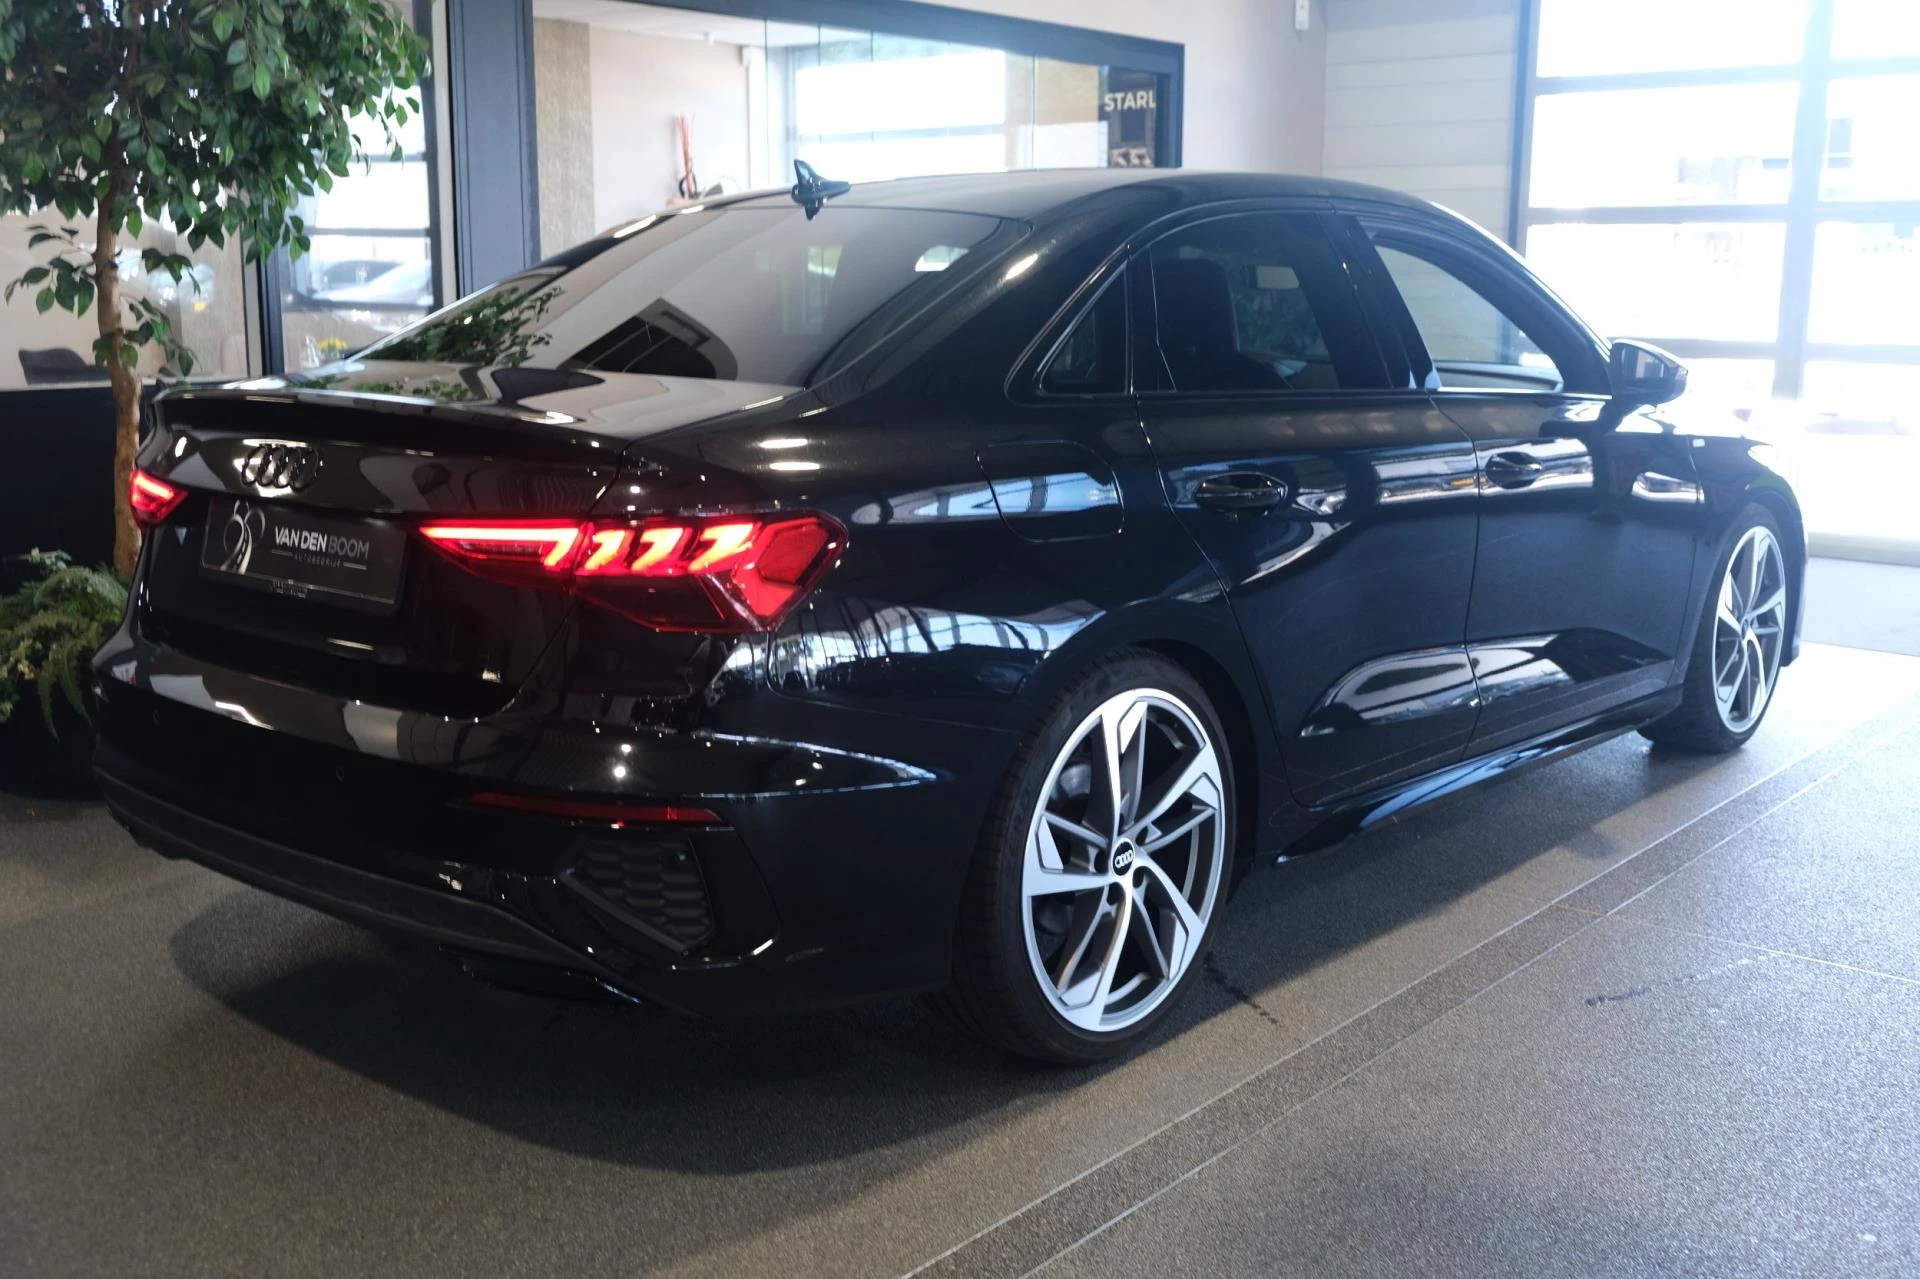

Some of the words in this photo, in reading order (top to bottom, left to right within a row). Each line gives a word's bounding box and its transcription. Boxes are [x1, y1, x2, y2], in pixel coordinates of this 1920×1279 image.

[275, 525, 300, 548] VAN
[300, 530, 328, 553] DEN
[328, 535, 370, 560] BOOM
